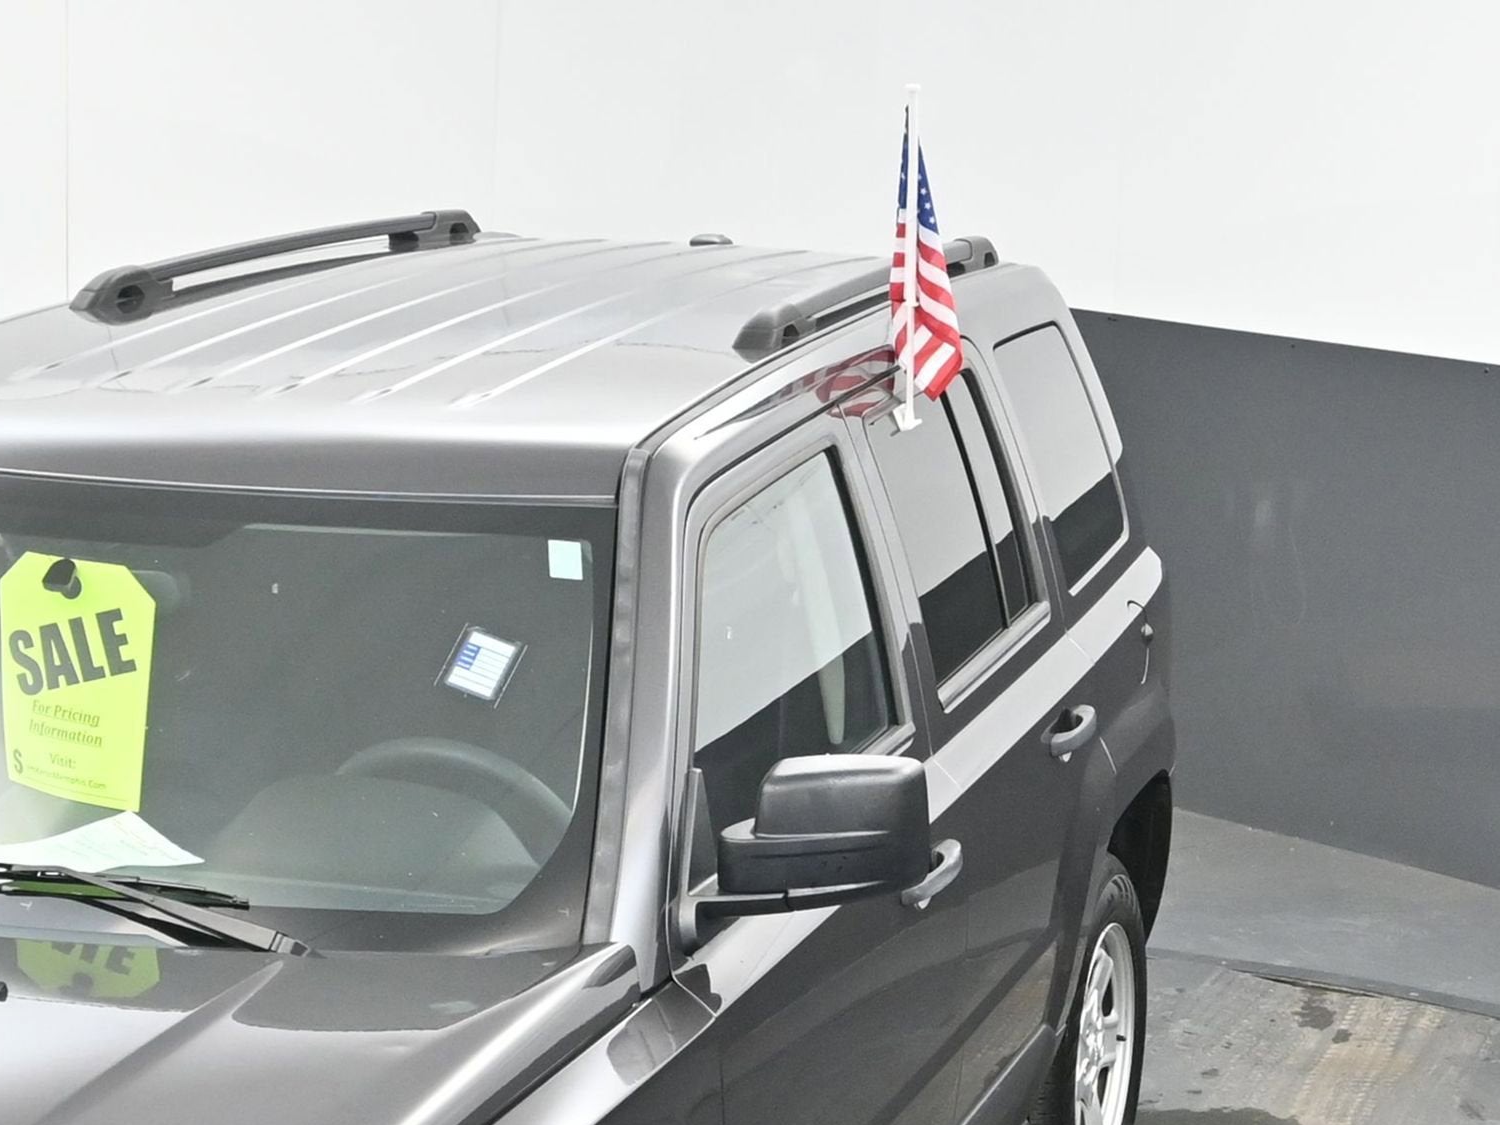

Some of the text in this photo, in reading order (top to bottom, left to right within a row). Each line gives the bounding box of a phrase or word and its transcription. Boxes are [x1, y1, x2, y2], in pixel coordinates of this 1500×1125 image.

[8, 608, 137, 695] SALE
[32, 699, 101, 728] For Pricing
[29, 719, 103, 746] Information
[13, 748, 24, 775] $
